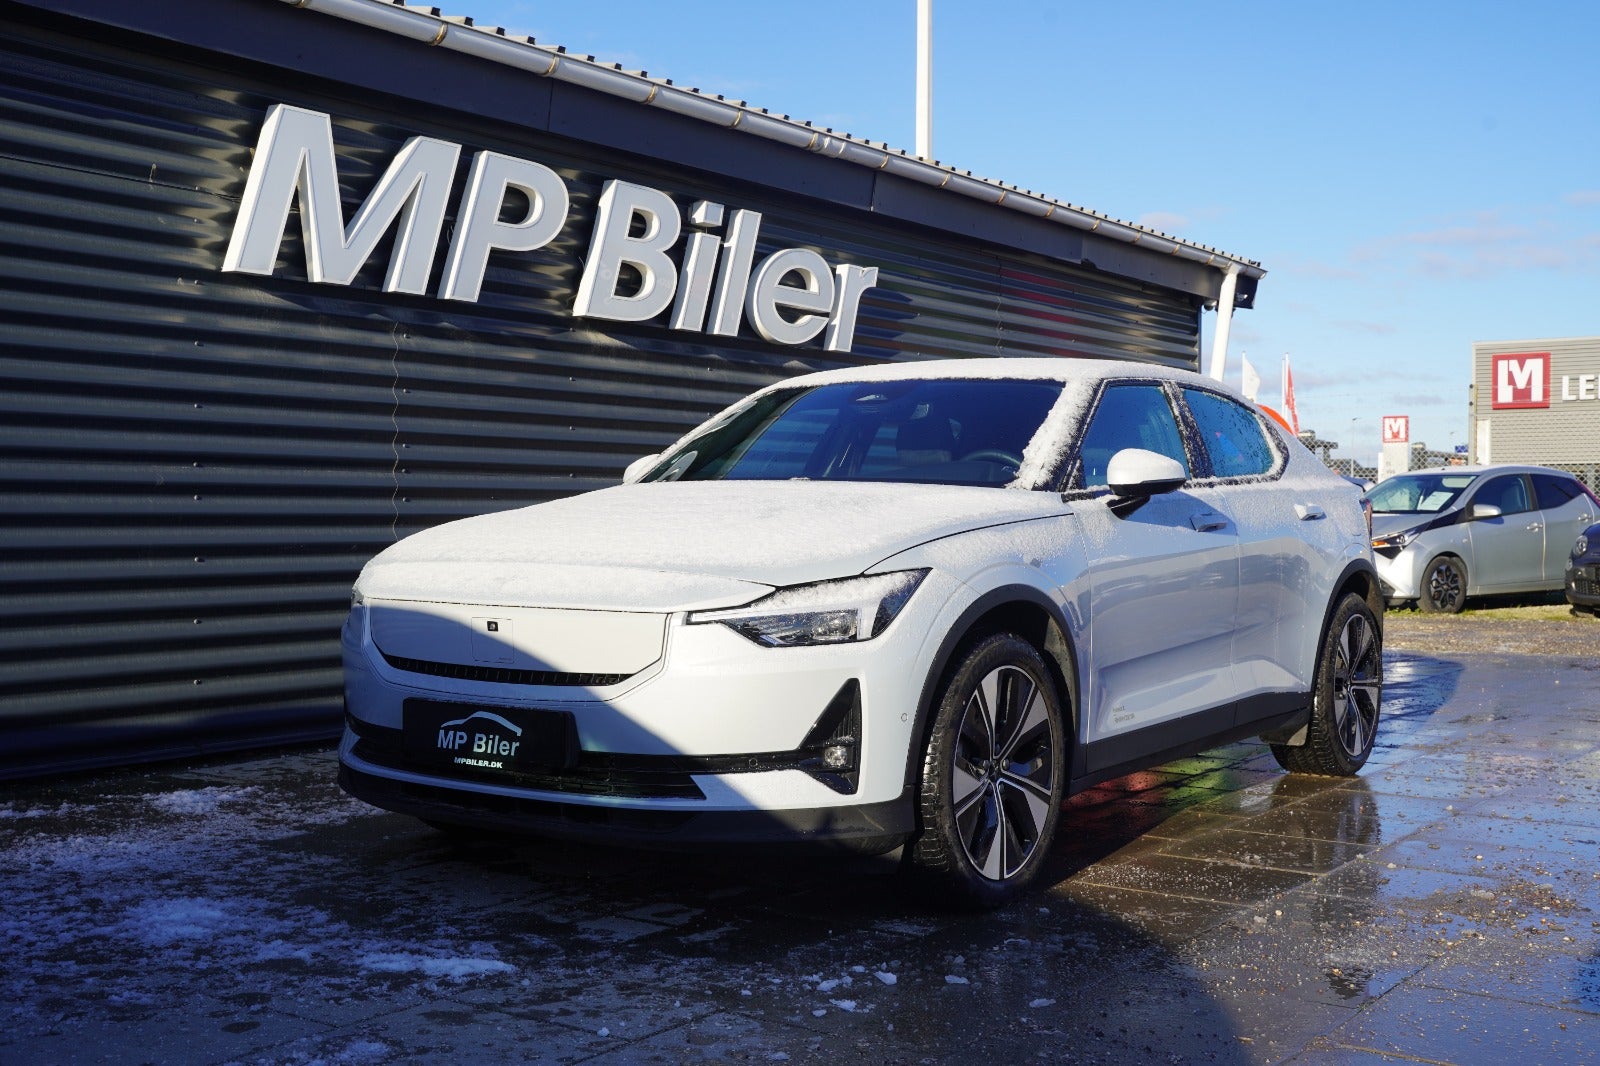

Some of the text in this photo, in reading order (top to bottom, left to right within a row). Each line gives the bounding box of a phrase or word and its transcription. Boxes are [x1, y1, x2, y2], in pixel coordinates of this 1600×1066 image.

[222, 103, 879, 353] MP Biler
[1562, 374, 1600, 401] LE
[437, 729, 520, 757] MP Biler
[453, 756, 503, 769] MPBILER.DK
